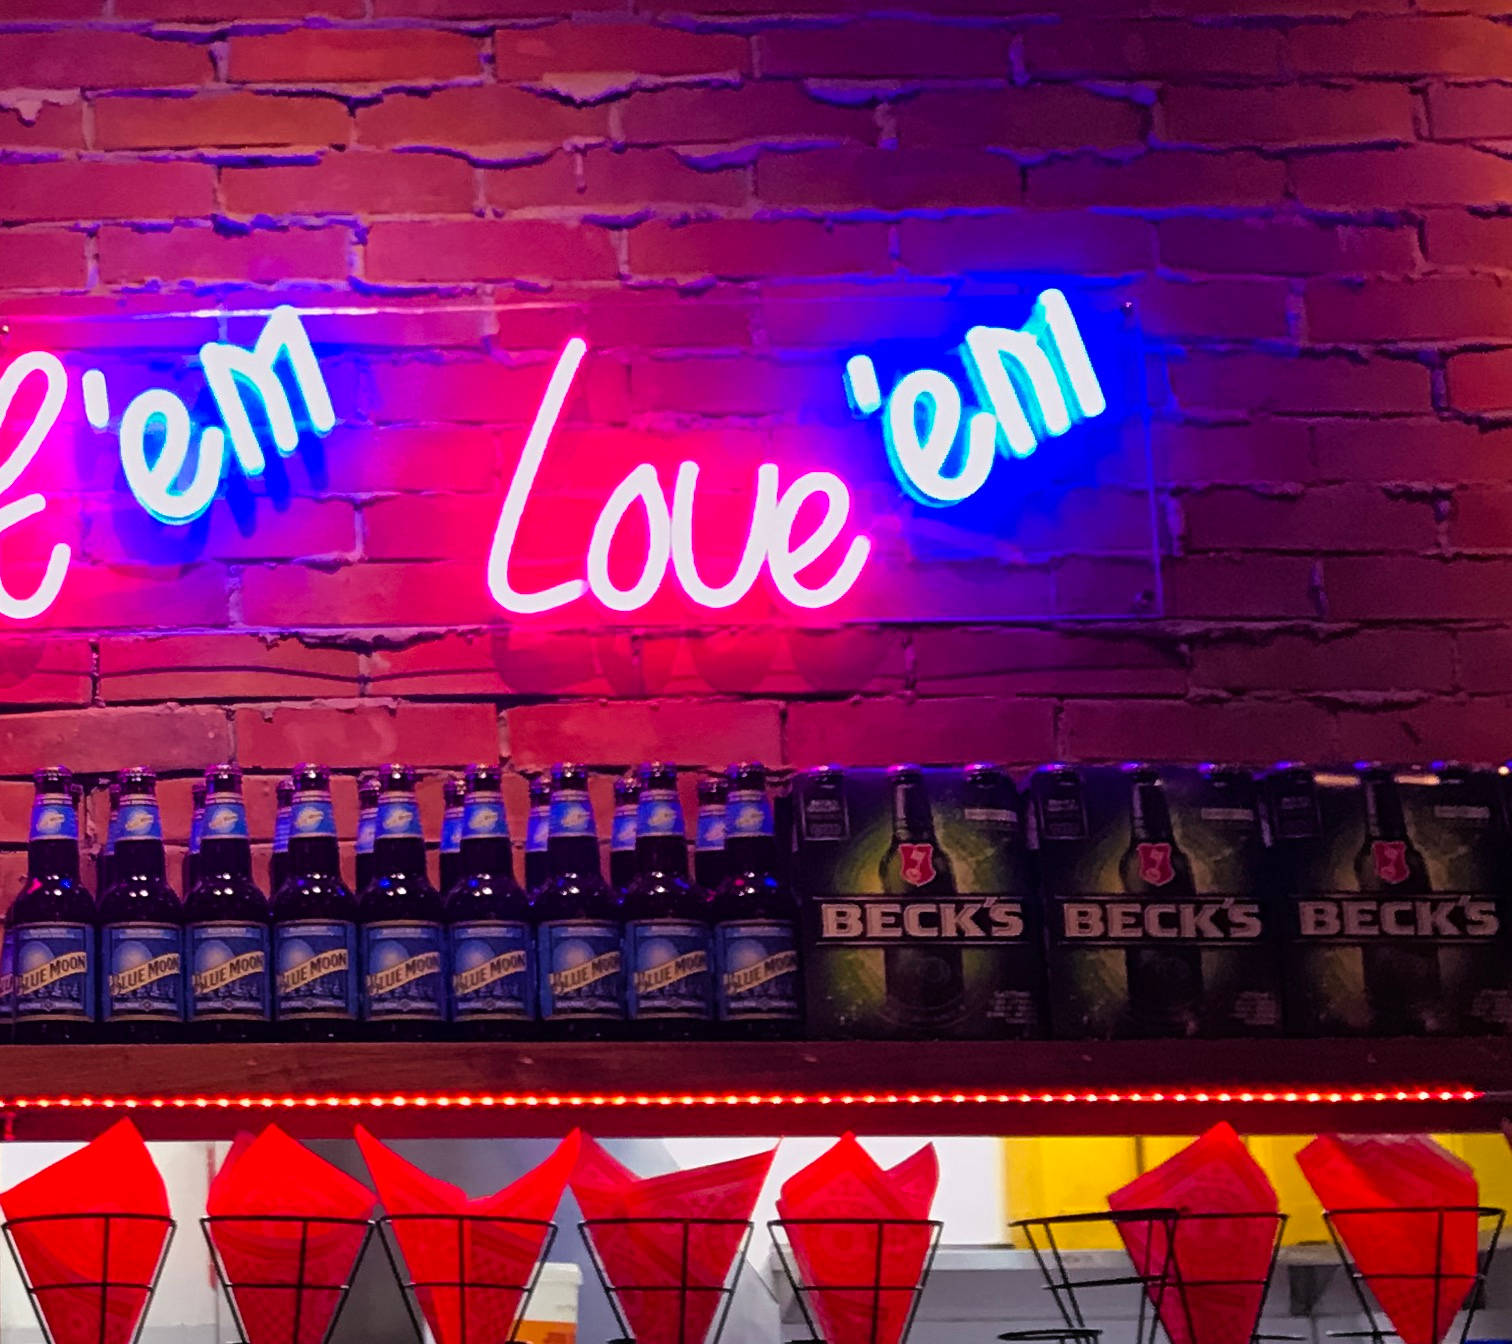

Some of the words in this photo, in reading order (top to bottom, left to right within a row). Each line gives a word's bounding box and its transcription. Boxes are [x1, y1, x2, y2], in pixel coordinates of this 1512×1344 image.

[488, 337, 871, 614] Love
[821, 897, 1025, 938] BECK'S
[1063, 897, 1263, 938] BECK'S
[1299, 895, 1500, 936] BECK'S
[16, 969, 47, 995] BLUE
[49, 954, 86, 975] MOON
[109, 970, 144, 995] BLUE
[146, 954, 179, 975] MOON
[193, 968, 227, 994] BLUE
[229, 953, 264, 974] MOON
[277, 967, 309, 993] BLUE
[311, 951, 347, 972] MOON
[366, 969, 402, 995] BLUE
[404, 954, 440, 975] MOON
[453, 969, 488, 994] BLUE
[490, 953, 525, 974] MOON
